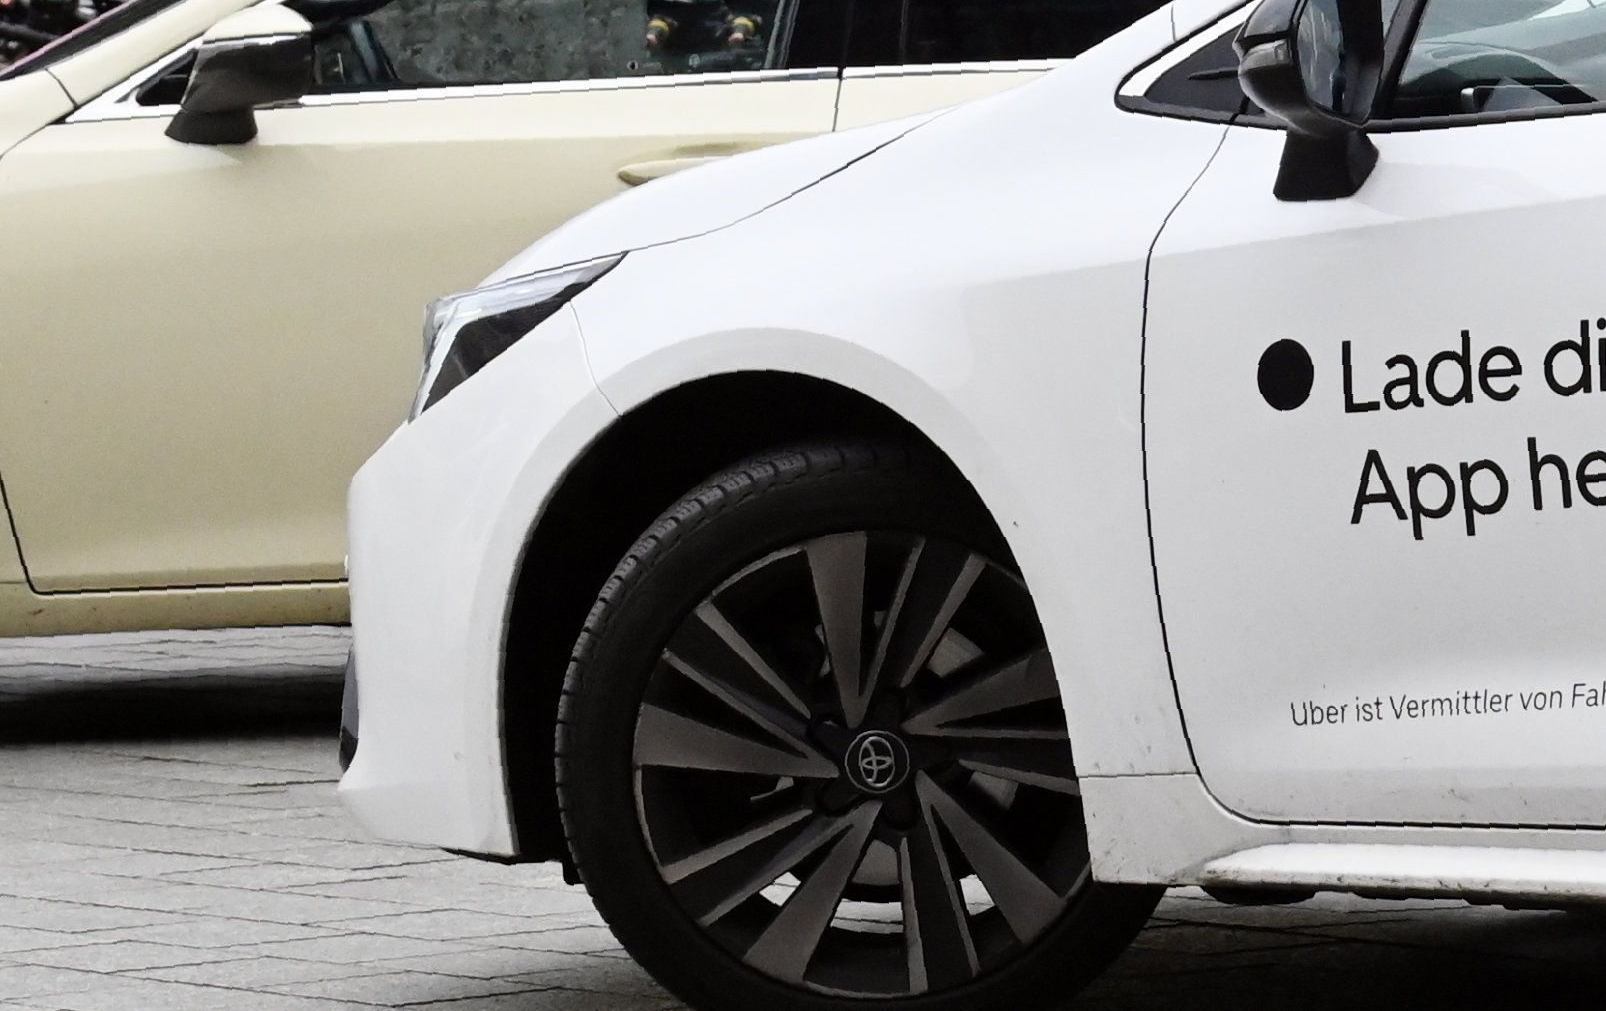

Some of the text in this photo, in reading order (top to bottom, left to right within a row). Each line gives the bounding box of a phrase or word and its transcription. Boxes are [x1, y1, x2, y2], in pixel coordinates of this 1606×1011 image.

[1341, 330, 1523, 414] Lade
[1350, 449, 1509, 541] App
[1290, 700, 1348, 727] Uber
[1355, 697, 1384, 722] ist
[1389, 689, 1513, 720] Vermittler
[1519, 691, 1563, 711] von
